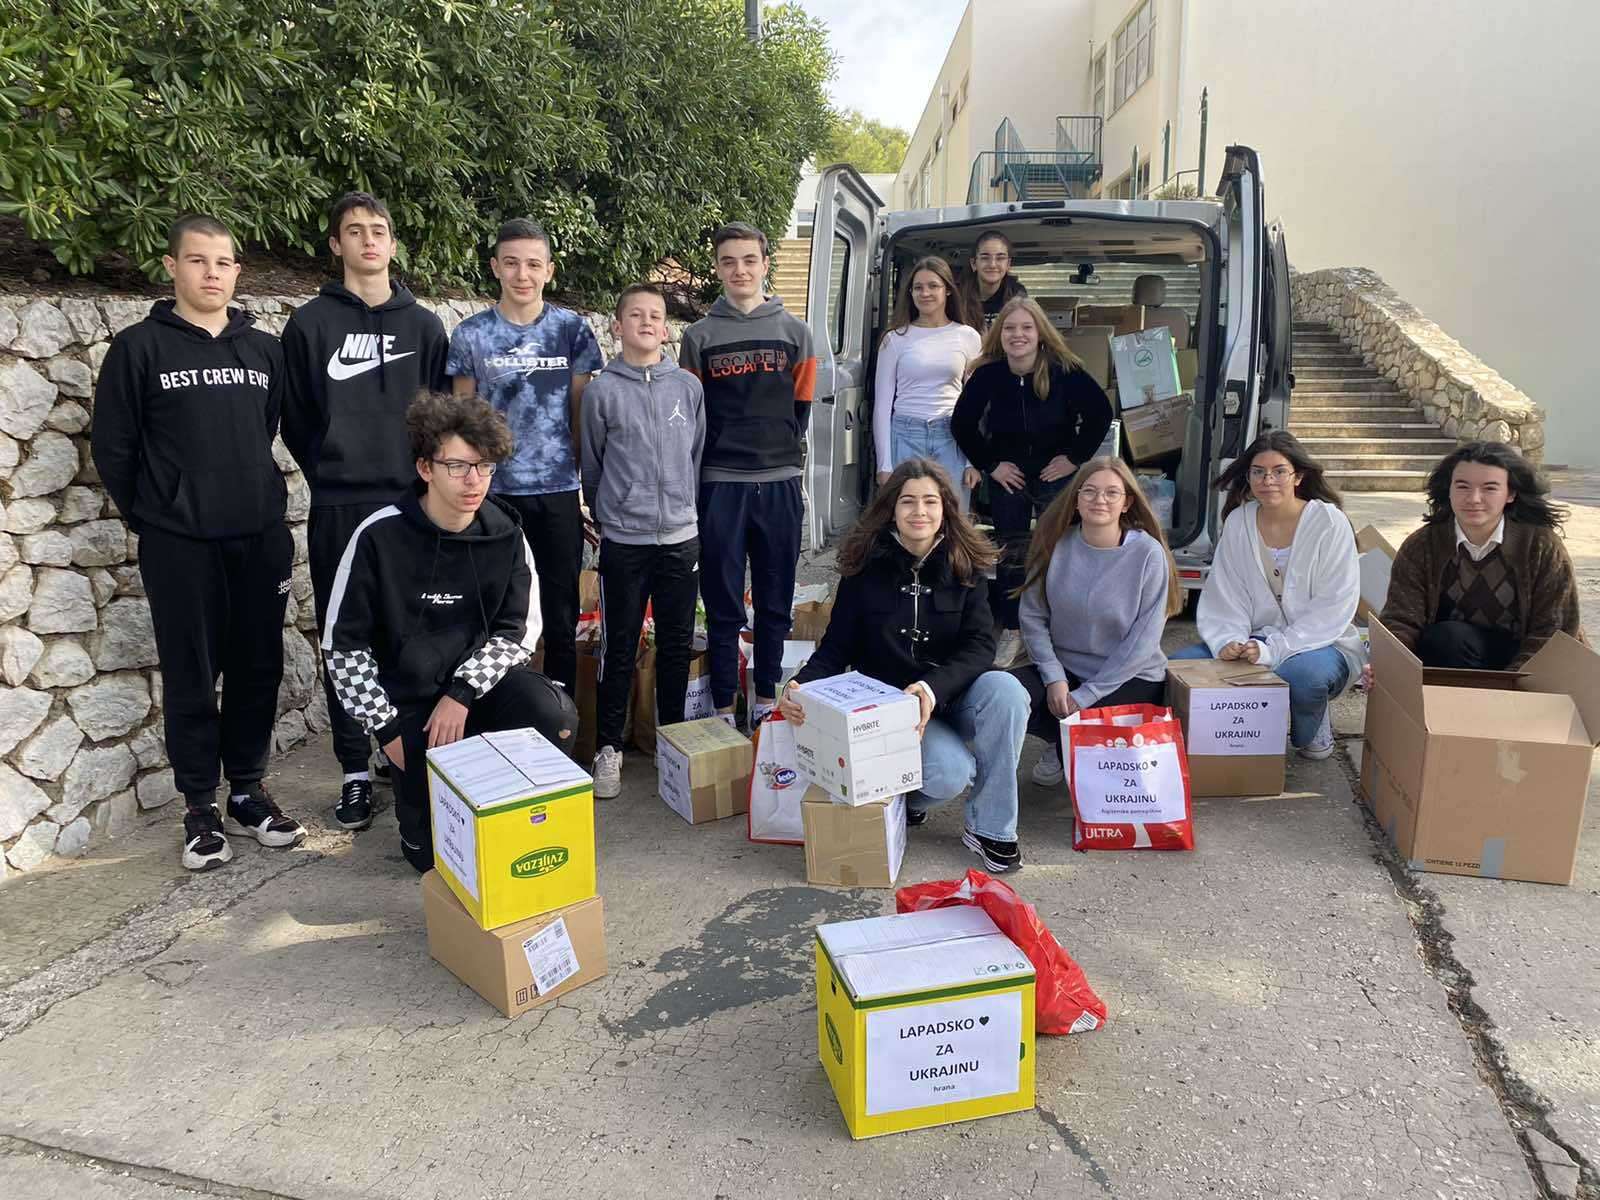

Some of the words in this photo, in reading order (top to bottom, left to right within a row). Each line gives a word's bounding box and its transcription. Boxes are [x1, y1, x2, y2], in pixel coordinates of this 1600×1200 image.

[340, 333, 397, 359] NIKE
[483, 356, 568, 368] HOLLISTER
[159, 369, 198, 390] BEST
[202, 368, 244, 385] CREW
[247, 369, 269, 390] EVE
[687, 687, 711, 698] ADSKO
[692, 702, 703, 710] ZA
[1210, 702, 1259, 710] LAPADSKO
[1232, 716, 1244, 724] ZA
[1215, 730, 1261, 739] UKRAJINU
[1098, 761, 1149, 771] LAPADSKO
[901, 772, 914, 784] 80
[1124, 778, 1137, 787] ZA
[1105, 794, 1157, 804] UKRAJINU
[1085, 828, 1124, 839] ULTRA
[516, 852, 564, 873] ZVIJEZDA
[900, 1018, 974, 1039] LAPADSKO
[936, 1044, 954, 1056] ZA
[909, 1060, 980, 1081] UKRAJINU
[933, 1084, 956, 1092] hrana
